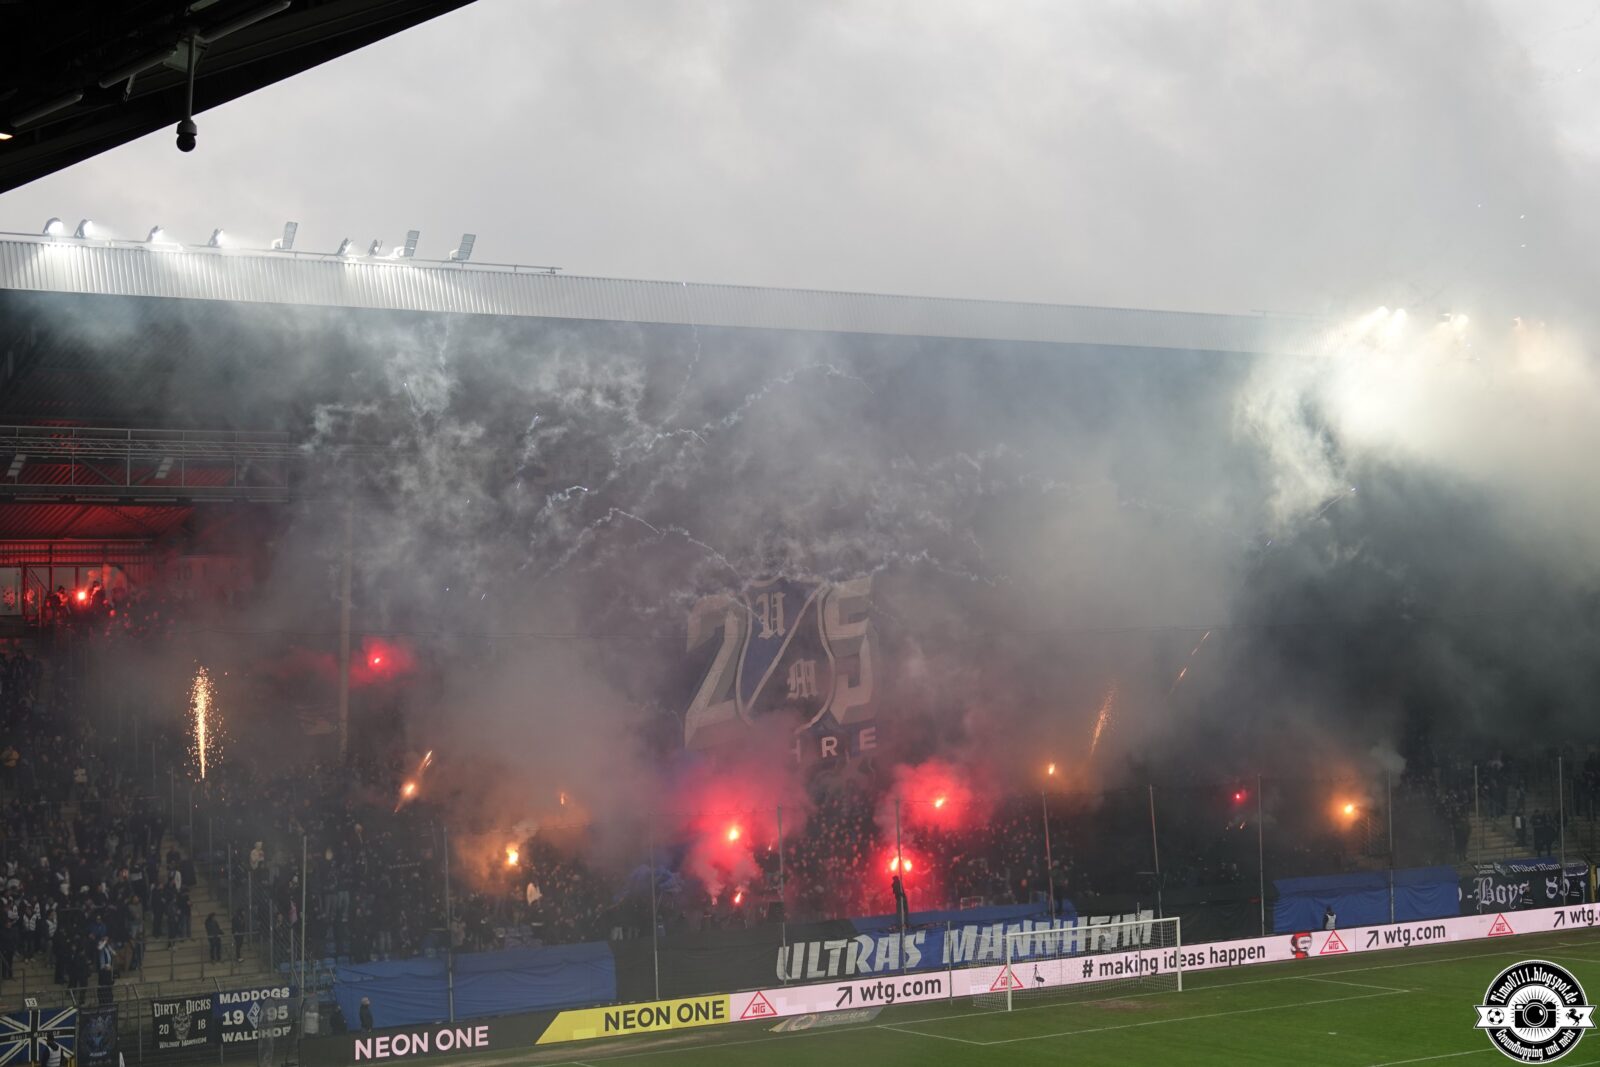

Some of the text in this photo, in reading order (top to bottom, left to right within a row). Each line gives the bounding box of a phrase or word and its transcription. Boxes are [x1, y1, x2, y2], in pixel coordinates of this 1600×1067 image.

[1384, 924, 1446, 946] wtg.com
[776, 929, 926, 982] ULTRAS
[1164, 949, 1205, 969] ideas
[1209, 944, 1266, 967] happen
[219, 987, 290, 1004] MADDOGS
[859, 977, 942, 1004] wtg.com
[153, 998, 212, 1018] DIRTY DICKS
[222, 1005, 289, 1026] 19 95
[603, 999, 726, 1032] NEON ONE
[752, 1002, 766, 1014] WTG
[159, 1018, 207, 1035] 20 18
[221, 1026, 292, 1043] WALDHOF
[354, 1025, 489, 1061] NEON ONE
